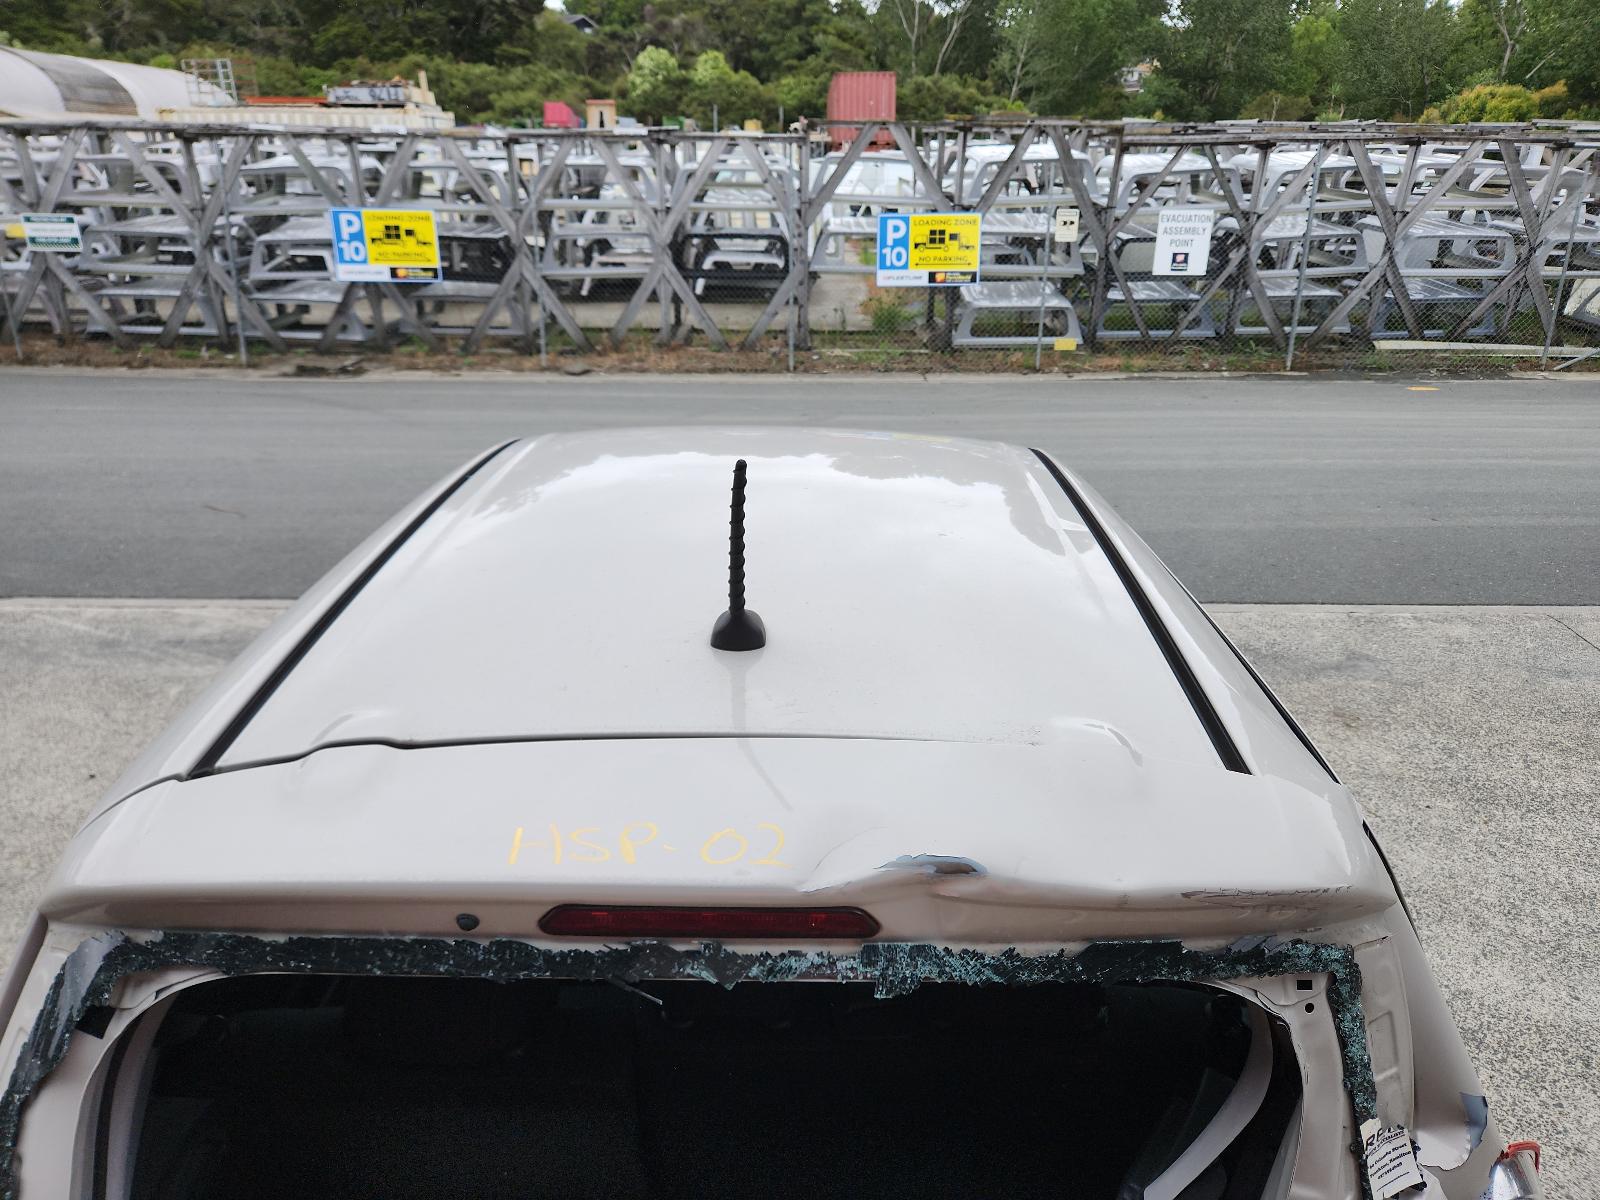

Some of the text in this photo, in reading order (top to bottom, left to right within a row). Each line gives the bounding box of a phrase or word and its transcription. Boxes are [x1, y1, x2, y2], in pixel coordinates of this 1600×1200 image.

[954, 218, 978, 226] ZONE
[1161, 213, 1212, 223] EVACUATION
[338, 212, 361, 241] P
[886, 218, 908, 246] P
[1163, 226, 1207, 236] ASSEMBLY
[1169, 239, 1193, 248] POINT
[338, 240, 366, 262] 10
[882, 246, 908, 268] 10
[1392, 1142, 1407, 1153] Street
[1389, 1150, 1412, 1164] Hamilton
